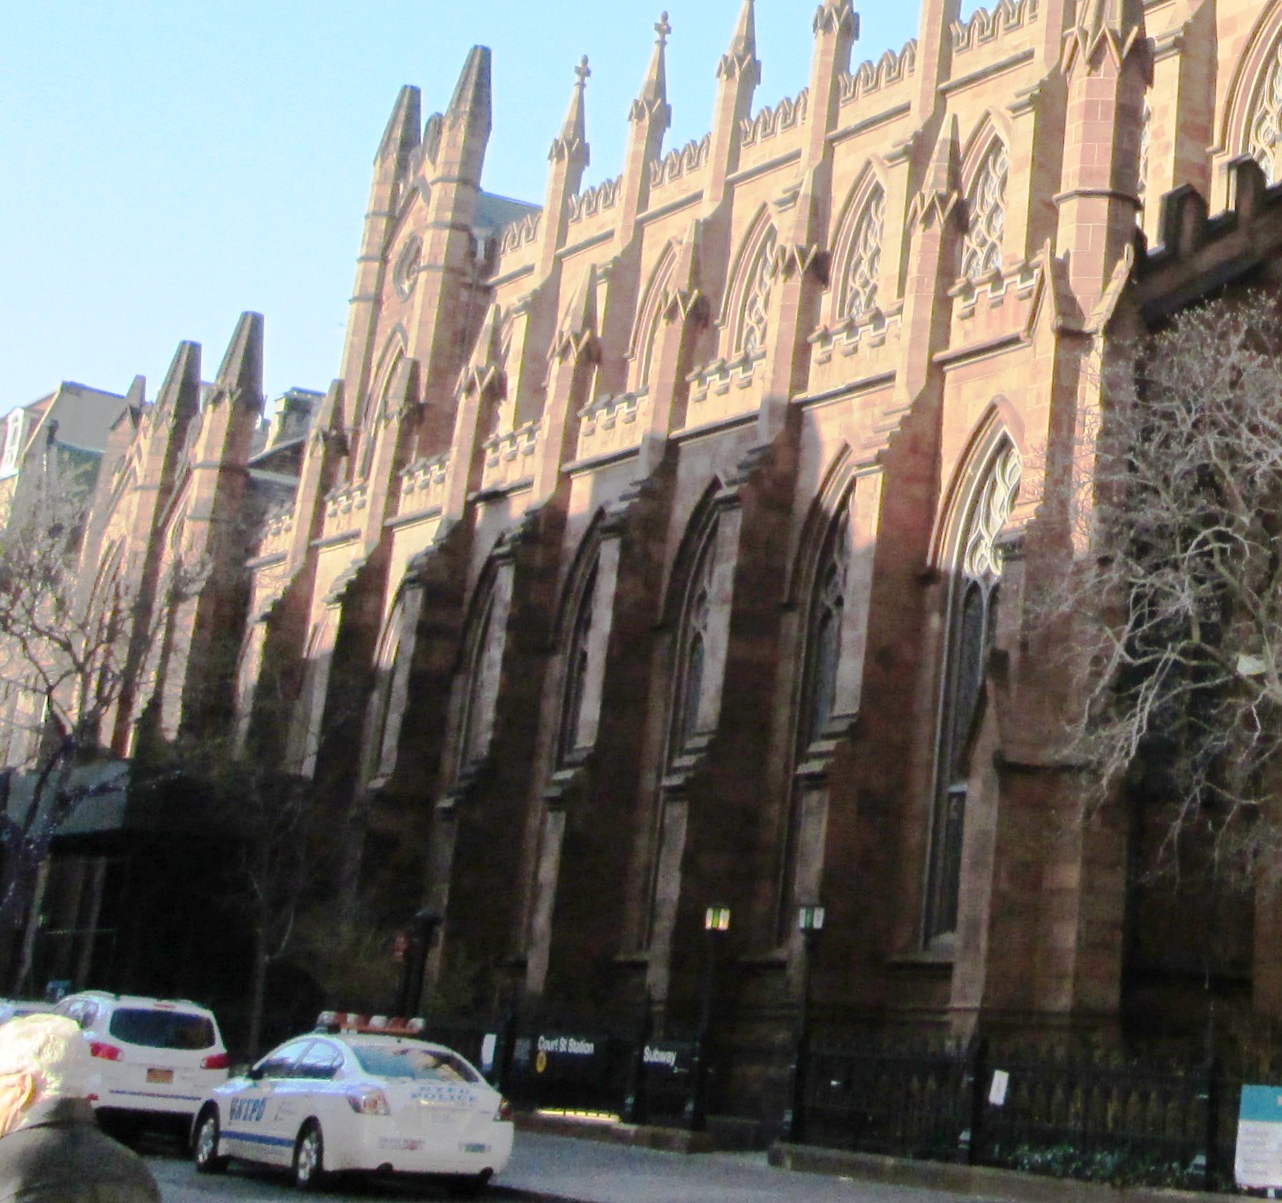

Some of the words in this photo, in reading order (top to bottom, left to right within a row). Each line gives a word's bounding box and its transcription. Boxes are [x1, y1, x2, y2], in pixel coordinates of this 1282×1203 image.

[538, 1035, 558, 1051] Court
[559, 1037, 567, 1052] St
[568, 1037, 594, 1054] Station
[643, 1045, 677, 1066] Subway
